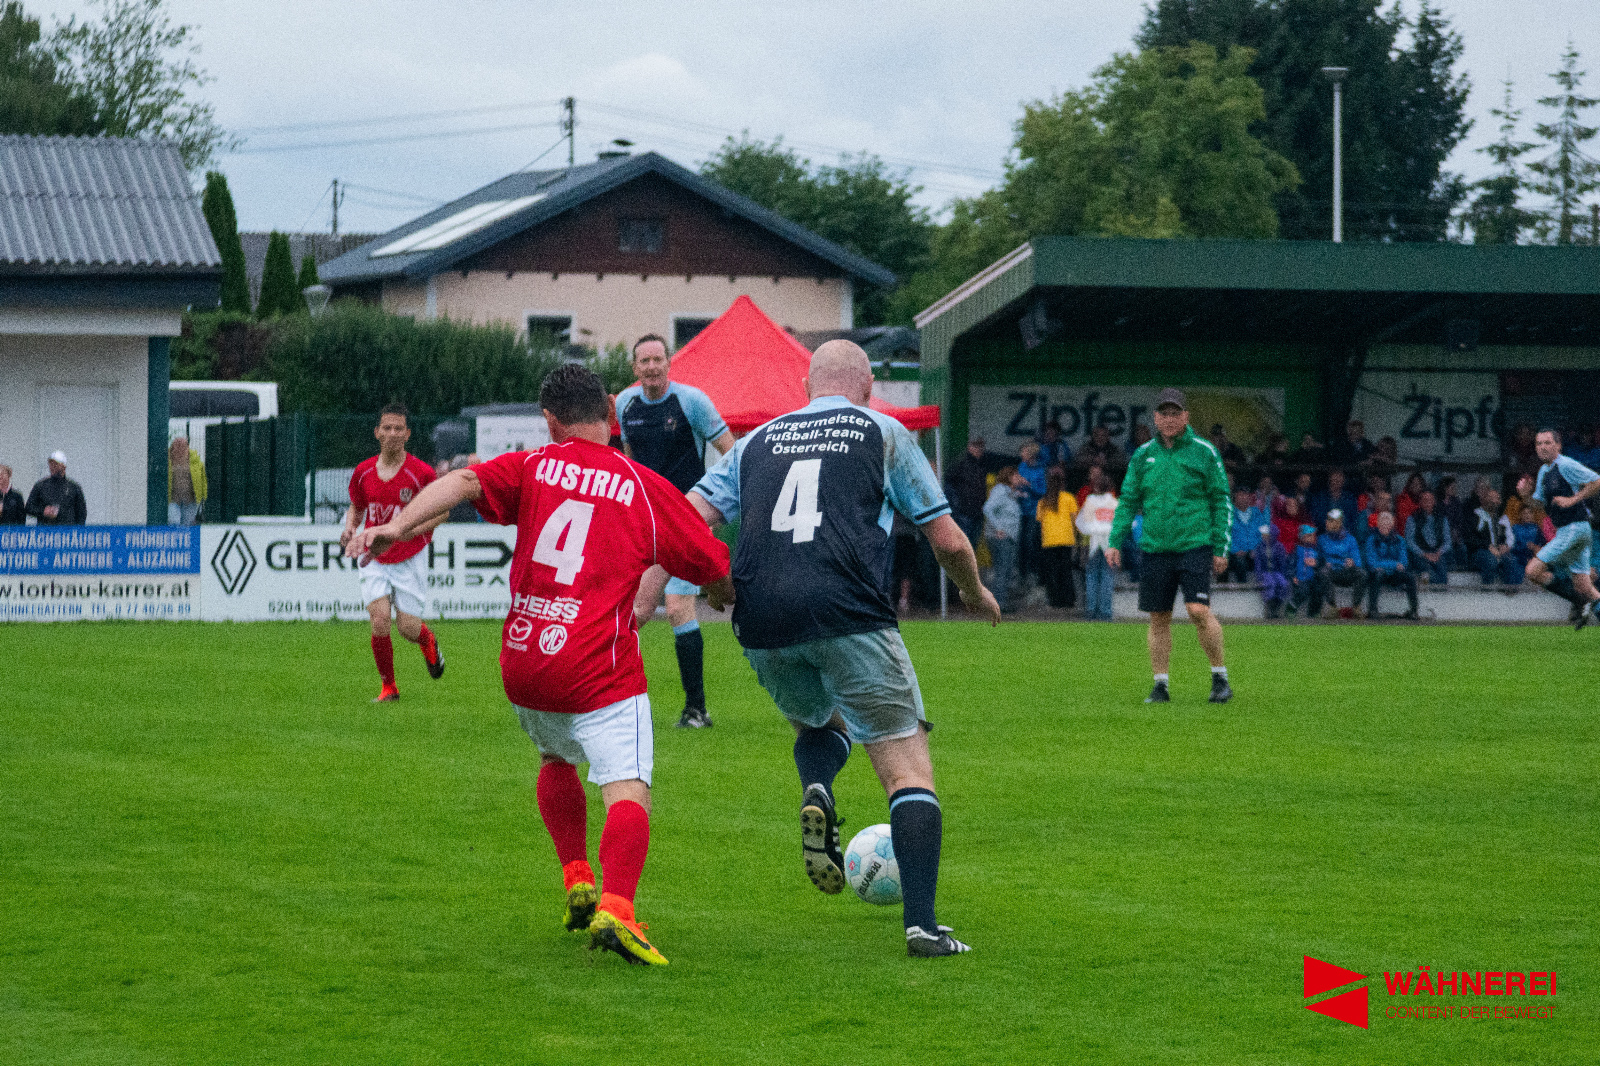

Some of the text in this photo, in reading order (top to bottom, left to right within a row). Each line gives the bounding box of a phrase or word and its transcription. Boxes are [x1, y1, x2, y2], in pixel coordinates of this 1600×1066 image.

[767, 413, 872, 433] Bürgermeister
[1004, 392, 1147, 438] Zipfer
[765, 427, 865, 443] Fußball-Team
[772, 441, 849, 454] Österreich
[535, 458, 636, 507] AUSTRIA
[771, 459, 823, 544] 4
[1, 530, 192, 549] GEWÄCHSHÄUSER FRÜHBEETE
[532, 498, 595, 586] 4
[53, 551, 113, 569] ANTRIEBE
[127, 549, 192, 569] ALUZÄUNE
[541, 626, 566, 653] MG
